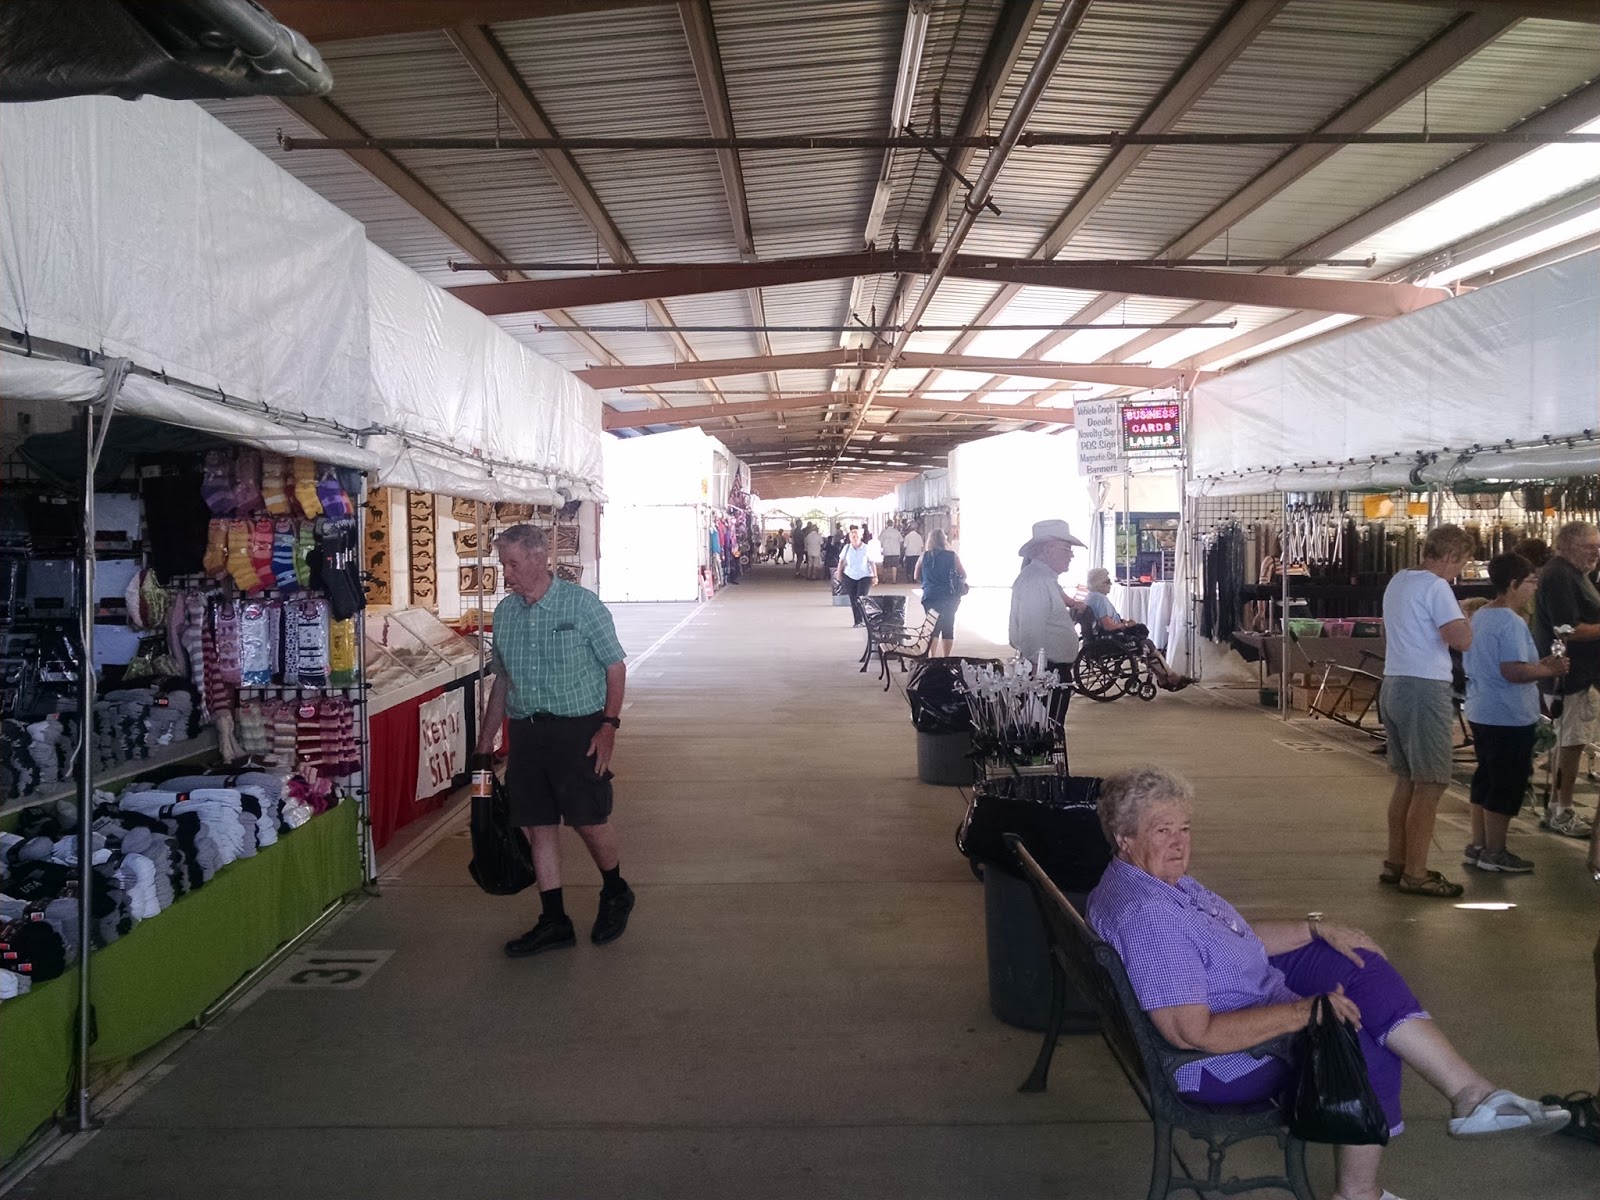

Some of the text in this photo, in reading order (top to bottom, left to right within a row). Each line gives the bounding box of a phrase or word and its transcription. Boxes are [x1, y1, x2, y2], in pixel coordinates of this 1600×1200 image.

[1077, 403, 1121, 416] Vehicle Graphi
[1126, 409, 1176, 421] BUSINESS
[1087, 416, 1113, 427] Decals
[1131, 422, 1172, 433] CARDS
[1079, 428, 1103, 439] Novelty
[1081, 440, 1097, 451] POS
[1129, 435, 1175, 447] LABELS
[1080, 452, 1107, 464] Magnetic
[1107, 451, 1123, 463] Sig
[1086, 464, 1118, 475] Banners
[20, 880, 43, 894] USA
[289, 958, 377, 985] 31
